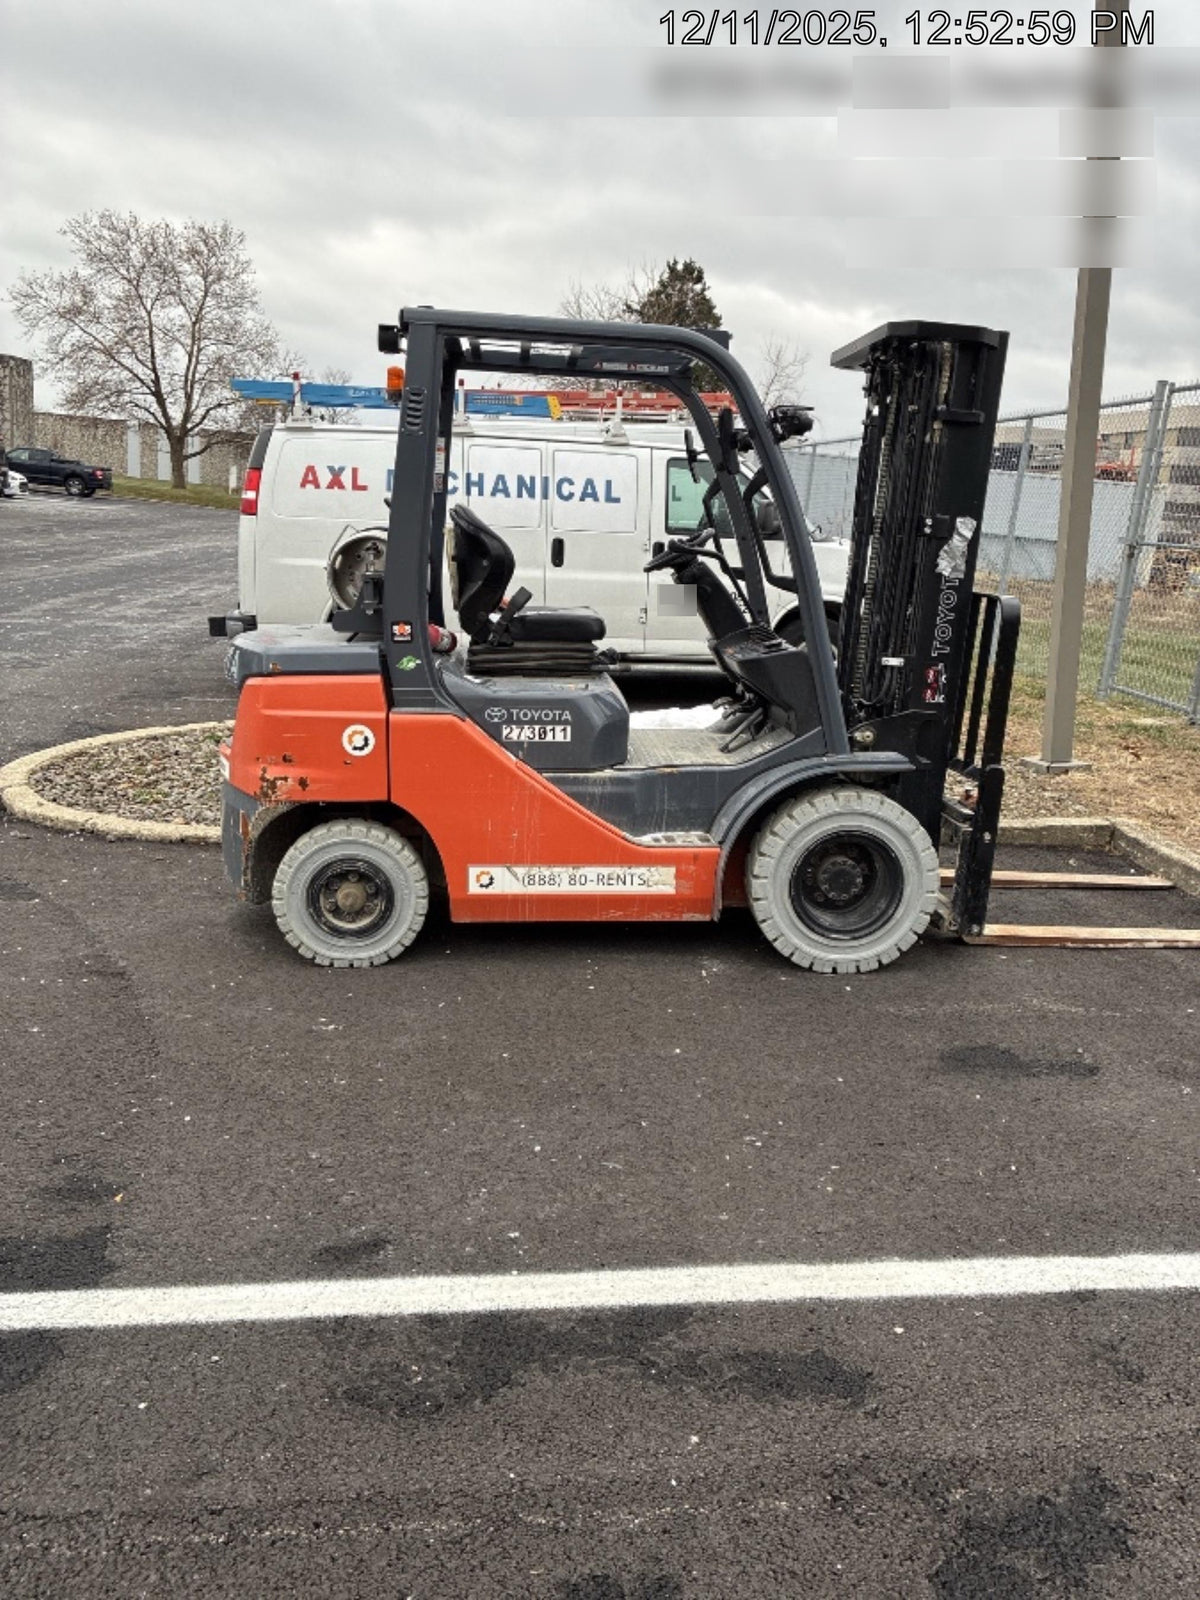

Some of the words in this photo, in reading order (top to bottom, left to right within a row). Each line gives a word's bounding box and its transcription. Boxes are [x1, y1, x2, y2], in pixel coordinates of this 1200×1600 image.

[300, 465, 368, 491] AXL
[385, 468, 621, 504] CHANICAL
[931, 575, 960, 657] TOYOT
[510, 709, 572, 721] TOYOTA
[504, 726, 568, 740] 273011
[568, 873, 647, 887] 80-RENTS
